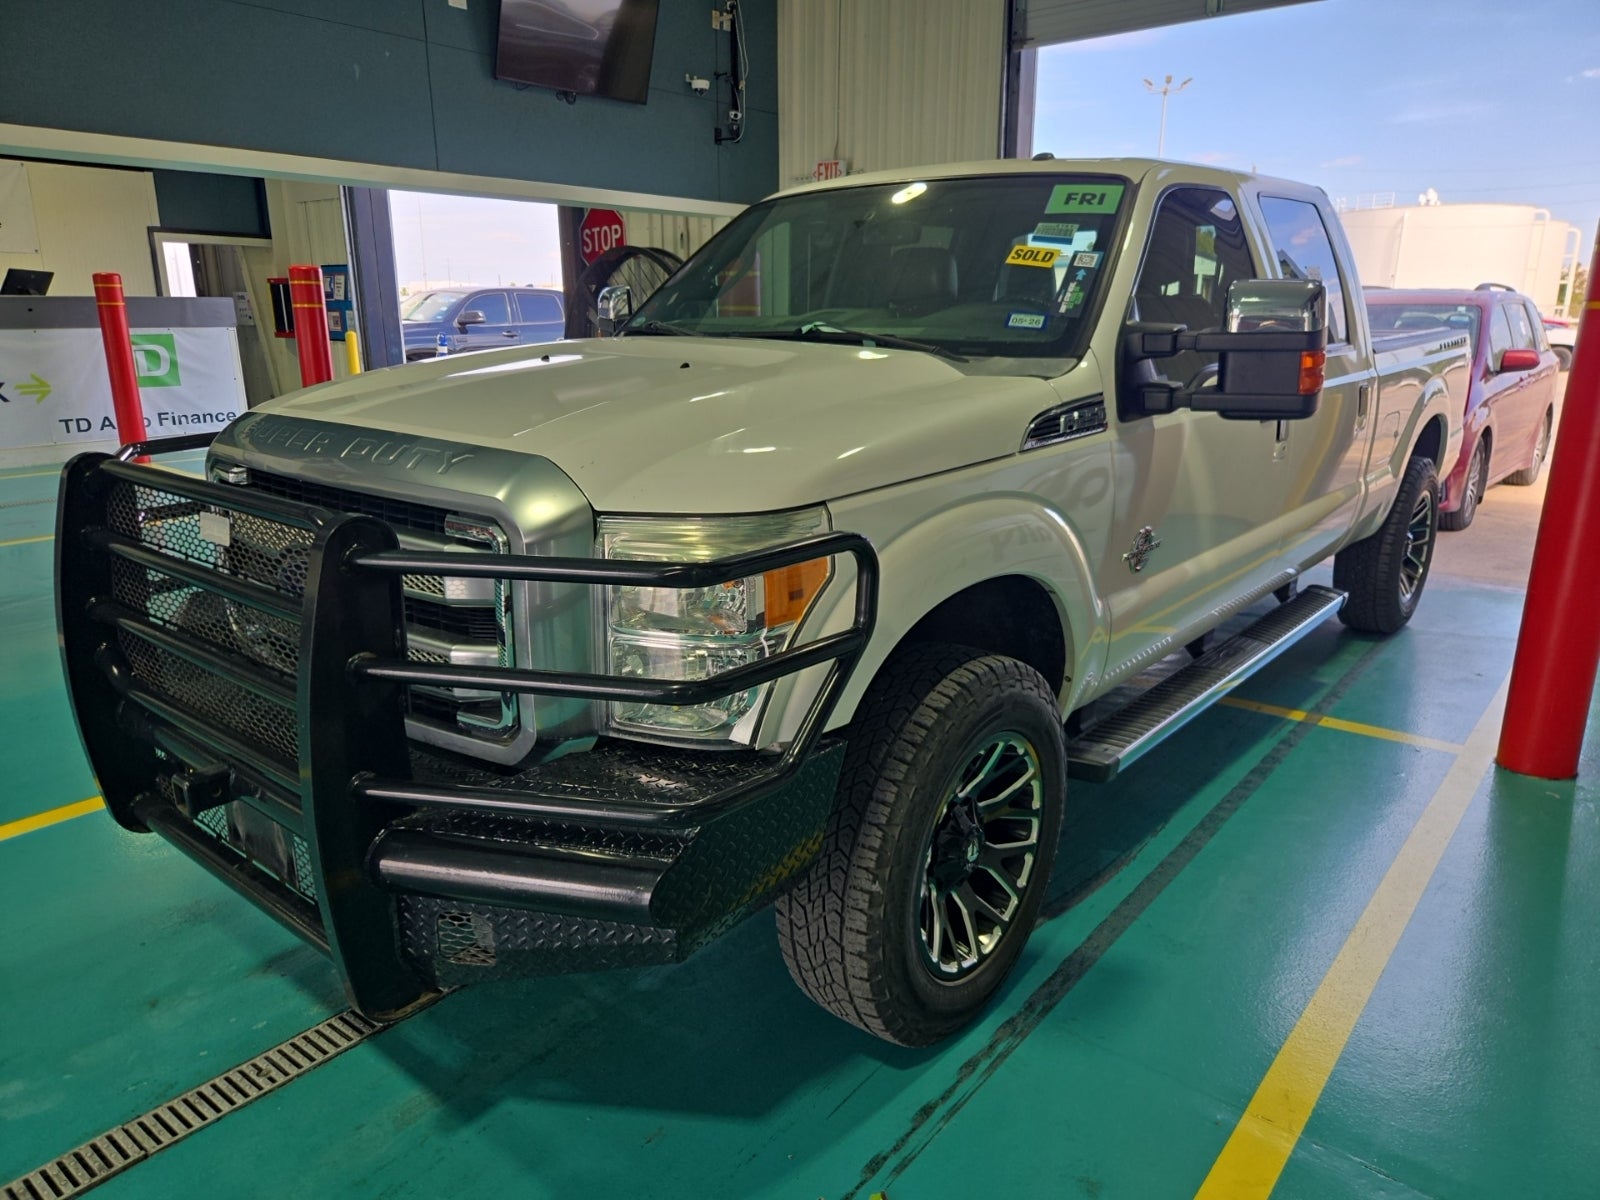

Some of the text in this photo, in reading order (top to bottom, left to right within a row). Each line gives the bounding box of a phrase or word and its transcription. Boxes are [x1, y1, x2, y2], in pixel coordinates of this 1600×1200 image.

[1064, 192, 1107, 206] FRI
[583, 225, 621, 253] STOP
[1011, 248, 1054, 263] SOLD
[133, 344, 171, 377] D
[58, 409, 237, 434] TD Ao Finance
[341, 436, 475, 475] DUTY
